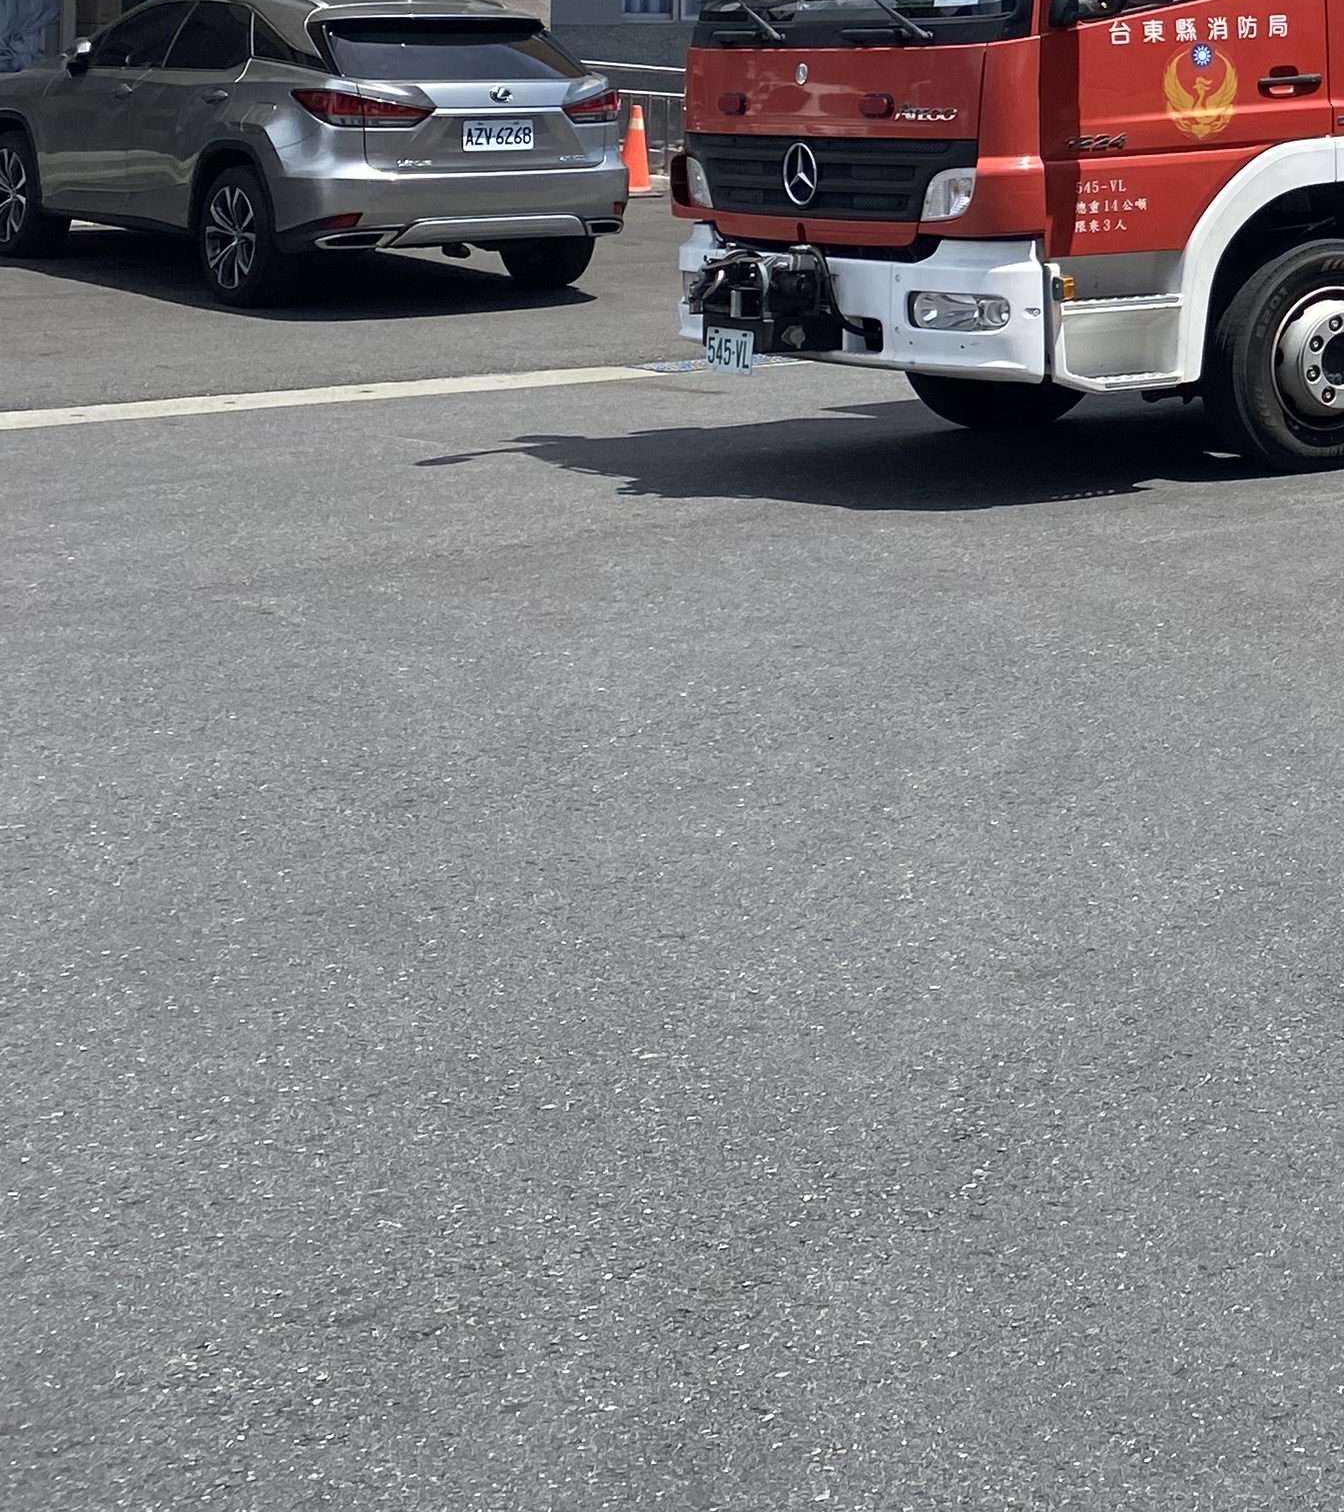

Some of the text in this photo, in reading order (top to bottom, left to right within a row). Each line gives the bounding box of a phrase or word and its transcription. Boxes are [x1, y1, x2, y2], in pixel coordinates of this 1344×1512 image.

[1109, 14, 1289, 45] 台東縣消防局
[1076, 179, 1127, 194] 545-VL
[707, 336, 749, 369] 545-VL
